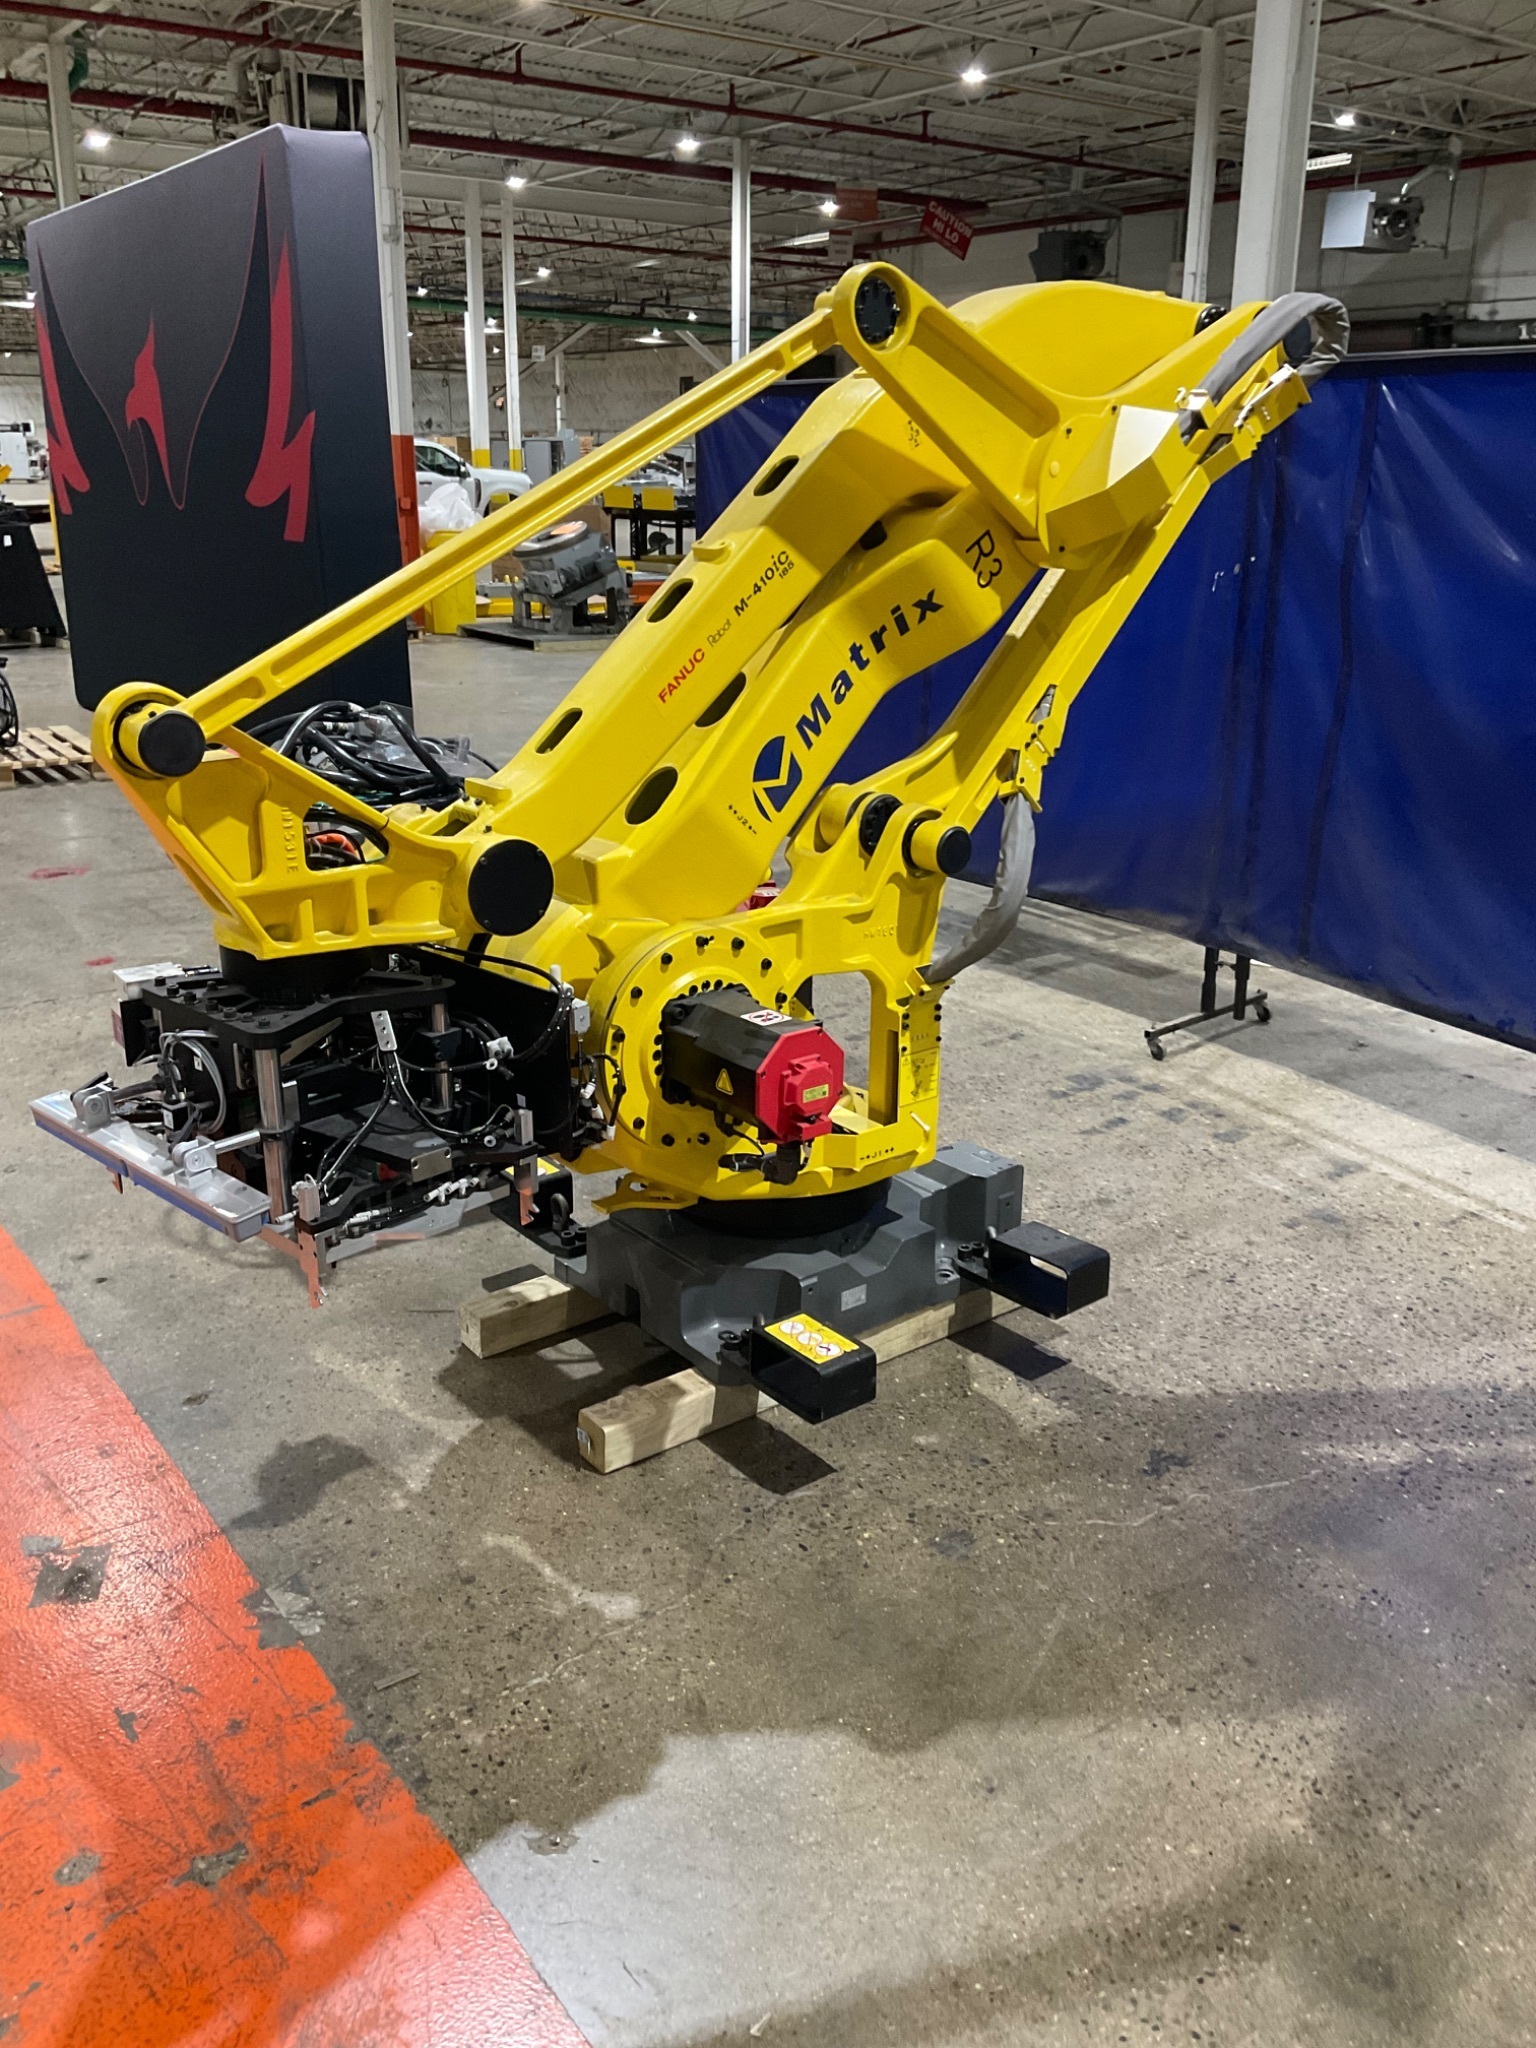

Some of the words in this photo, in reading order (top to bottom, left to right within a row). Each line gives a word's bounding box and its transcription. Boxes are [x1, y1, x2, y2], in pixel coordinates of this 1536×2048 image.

[929, 201, 973, 238] CAUTION
[944, 226, 960, 244] LO
[778, 560, 795, 579] 185
[964, 529, 1003, 589] R3
[658, 648, 705, 703] FANUC
[706, 618, 732, 648] Robot
[795, 588, 944, 751] Matrix
